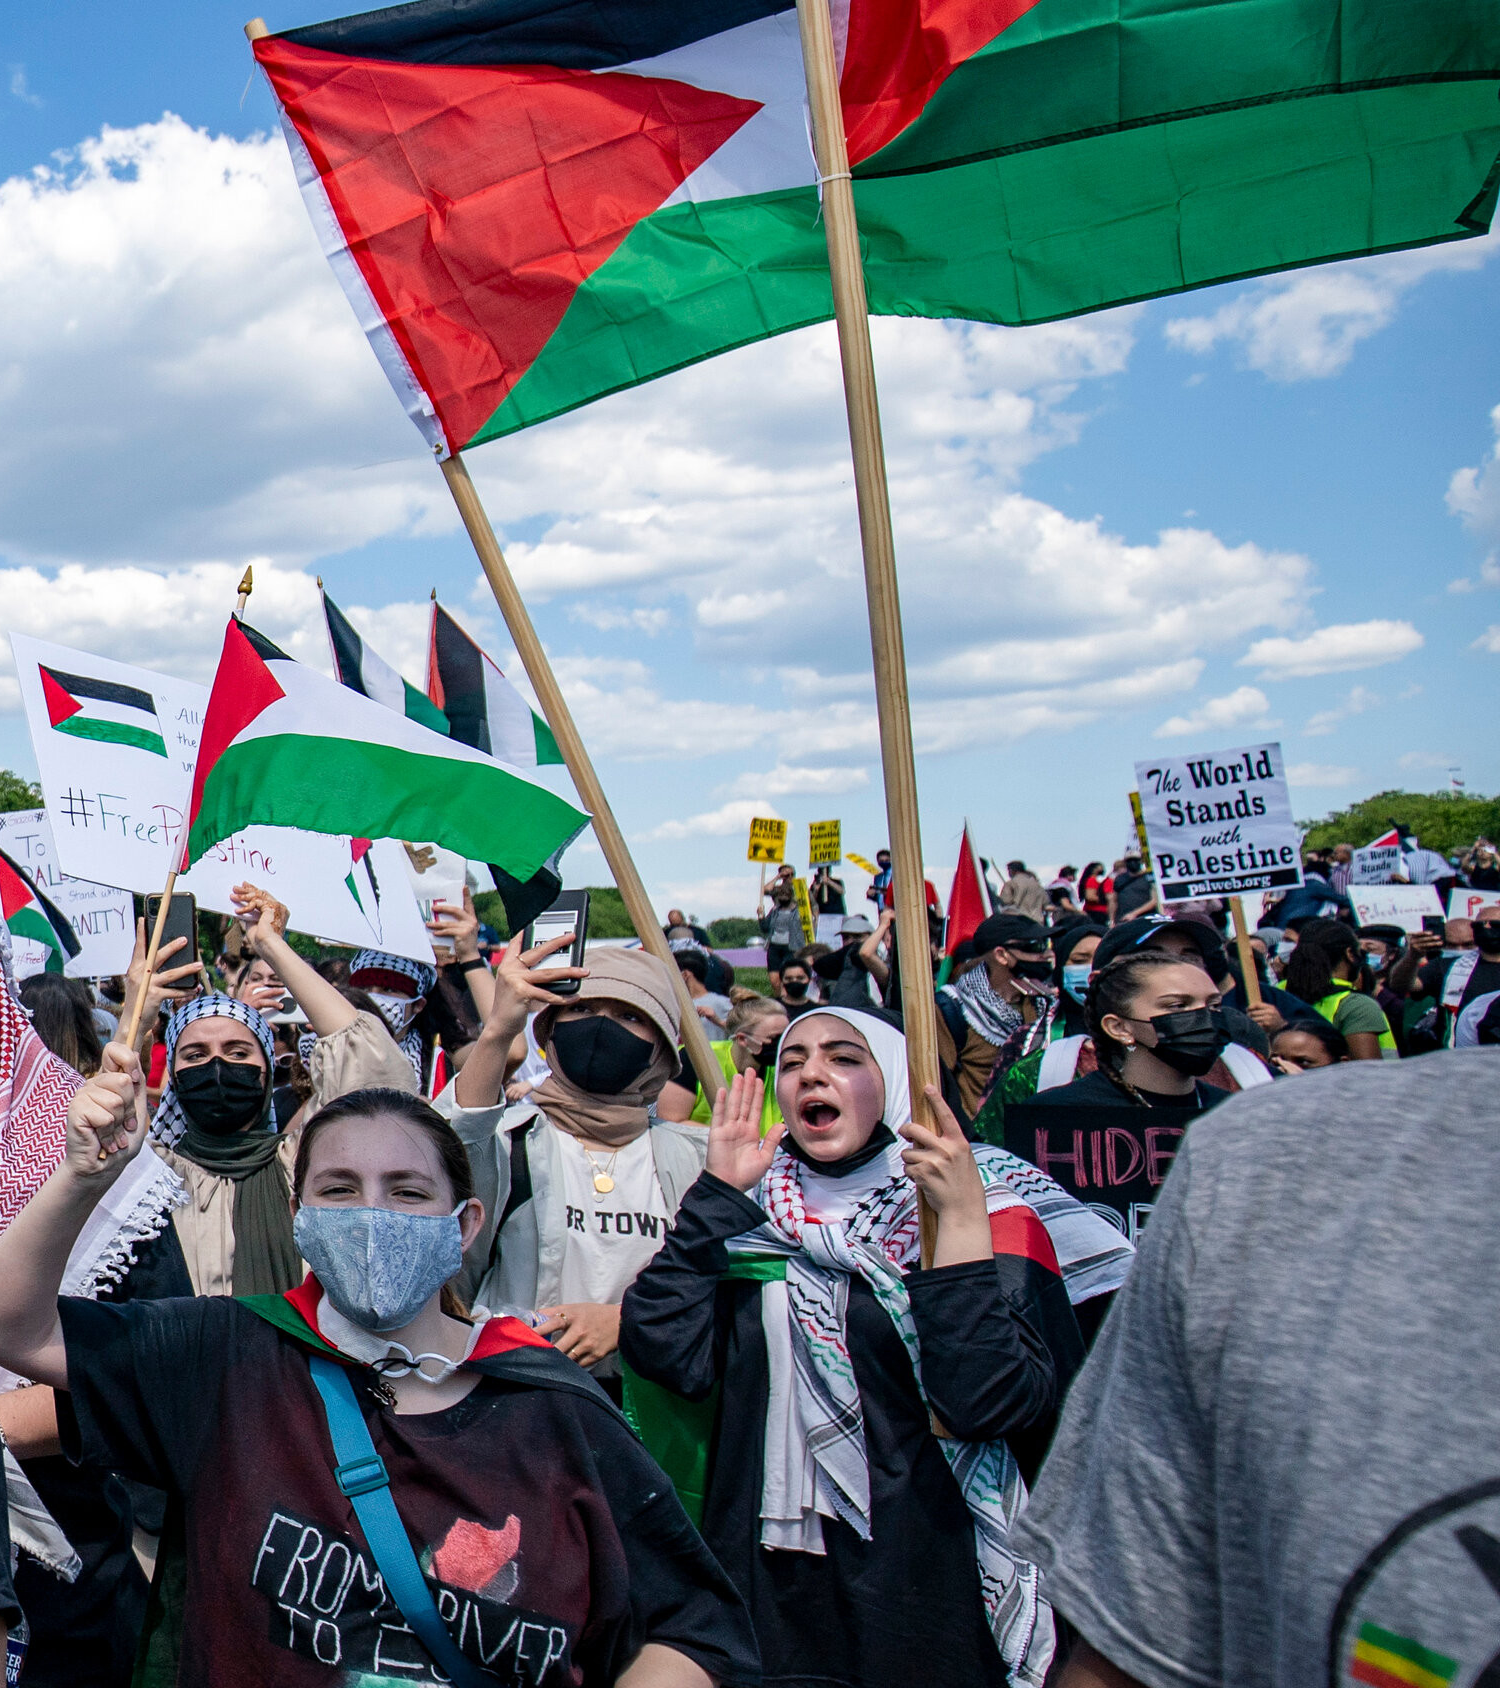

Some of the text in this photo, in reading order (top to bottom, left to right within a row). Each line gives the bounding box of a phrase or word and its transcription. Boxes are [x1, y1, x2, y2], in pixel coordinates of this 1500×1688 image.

[176, 732, 197, 748] the
[1147, 750, 1274, 795] The World
[1166, 789, 1267, 827] Stands
[1201, 825, 1242, 846] with
[1156, 843, 1294, 879] Palestine
[1188, 874, 1272, 896] pslweb.org
[71, 905, 126, 936] ANITY
[253, 1513, 387, 1619] FROM
[277, 1601, 342, 1665] TO
